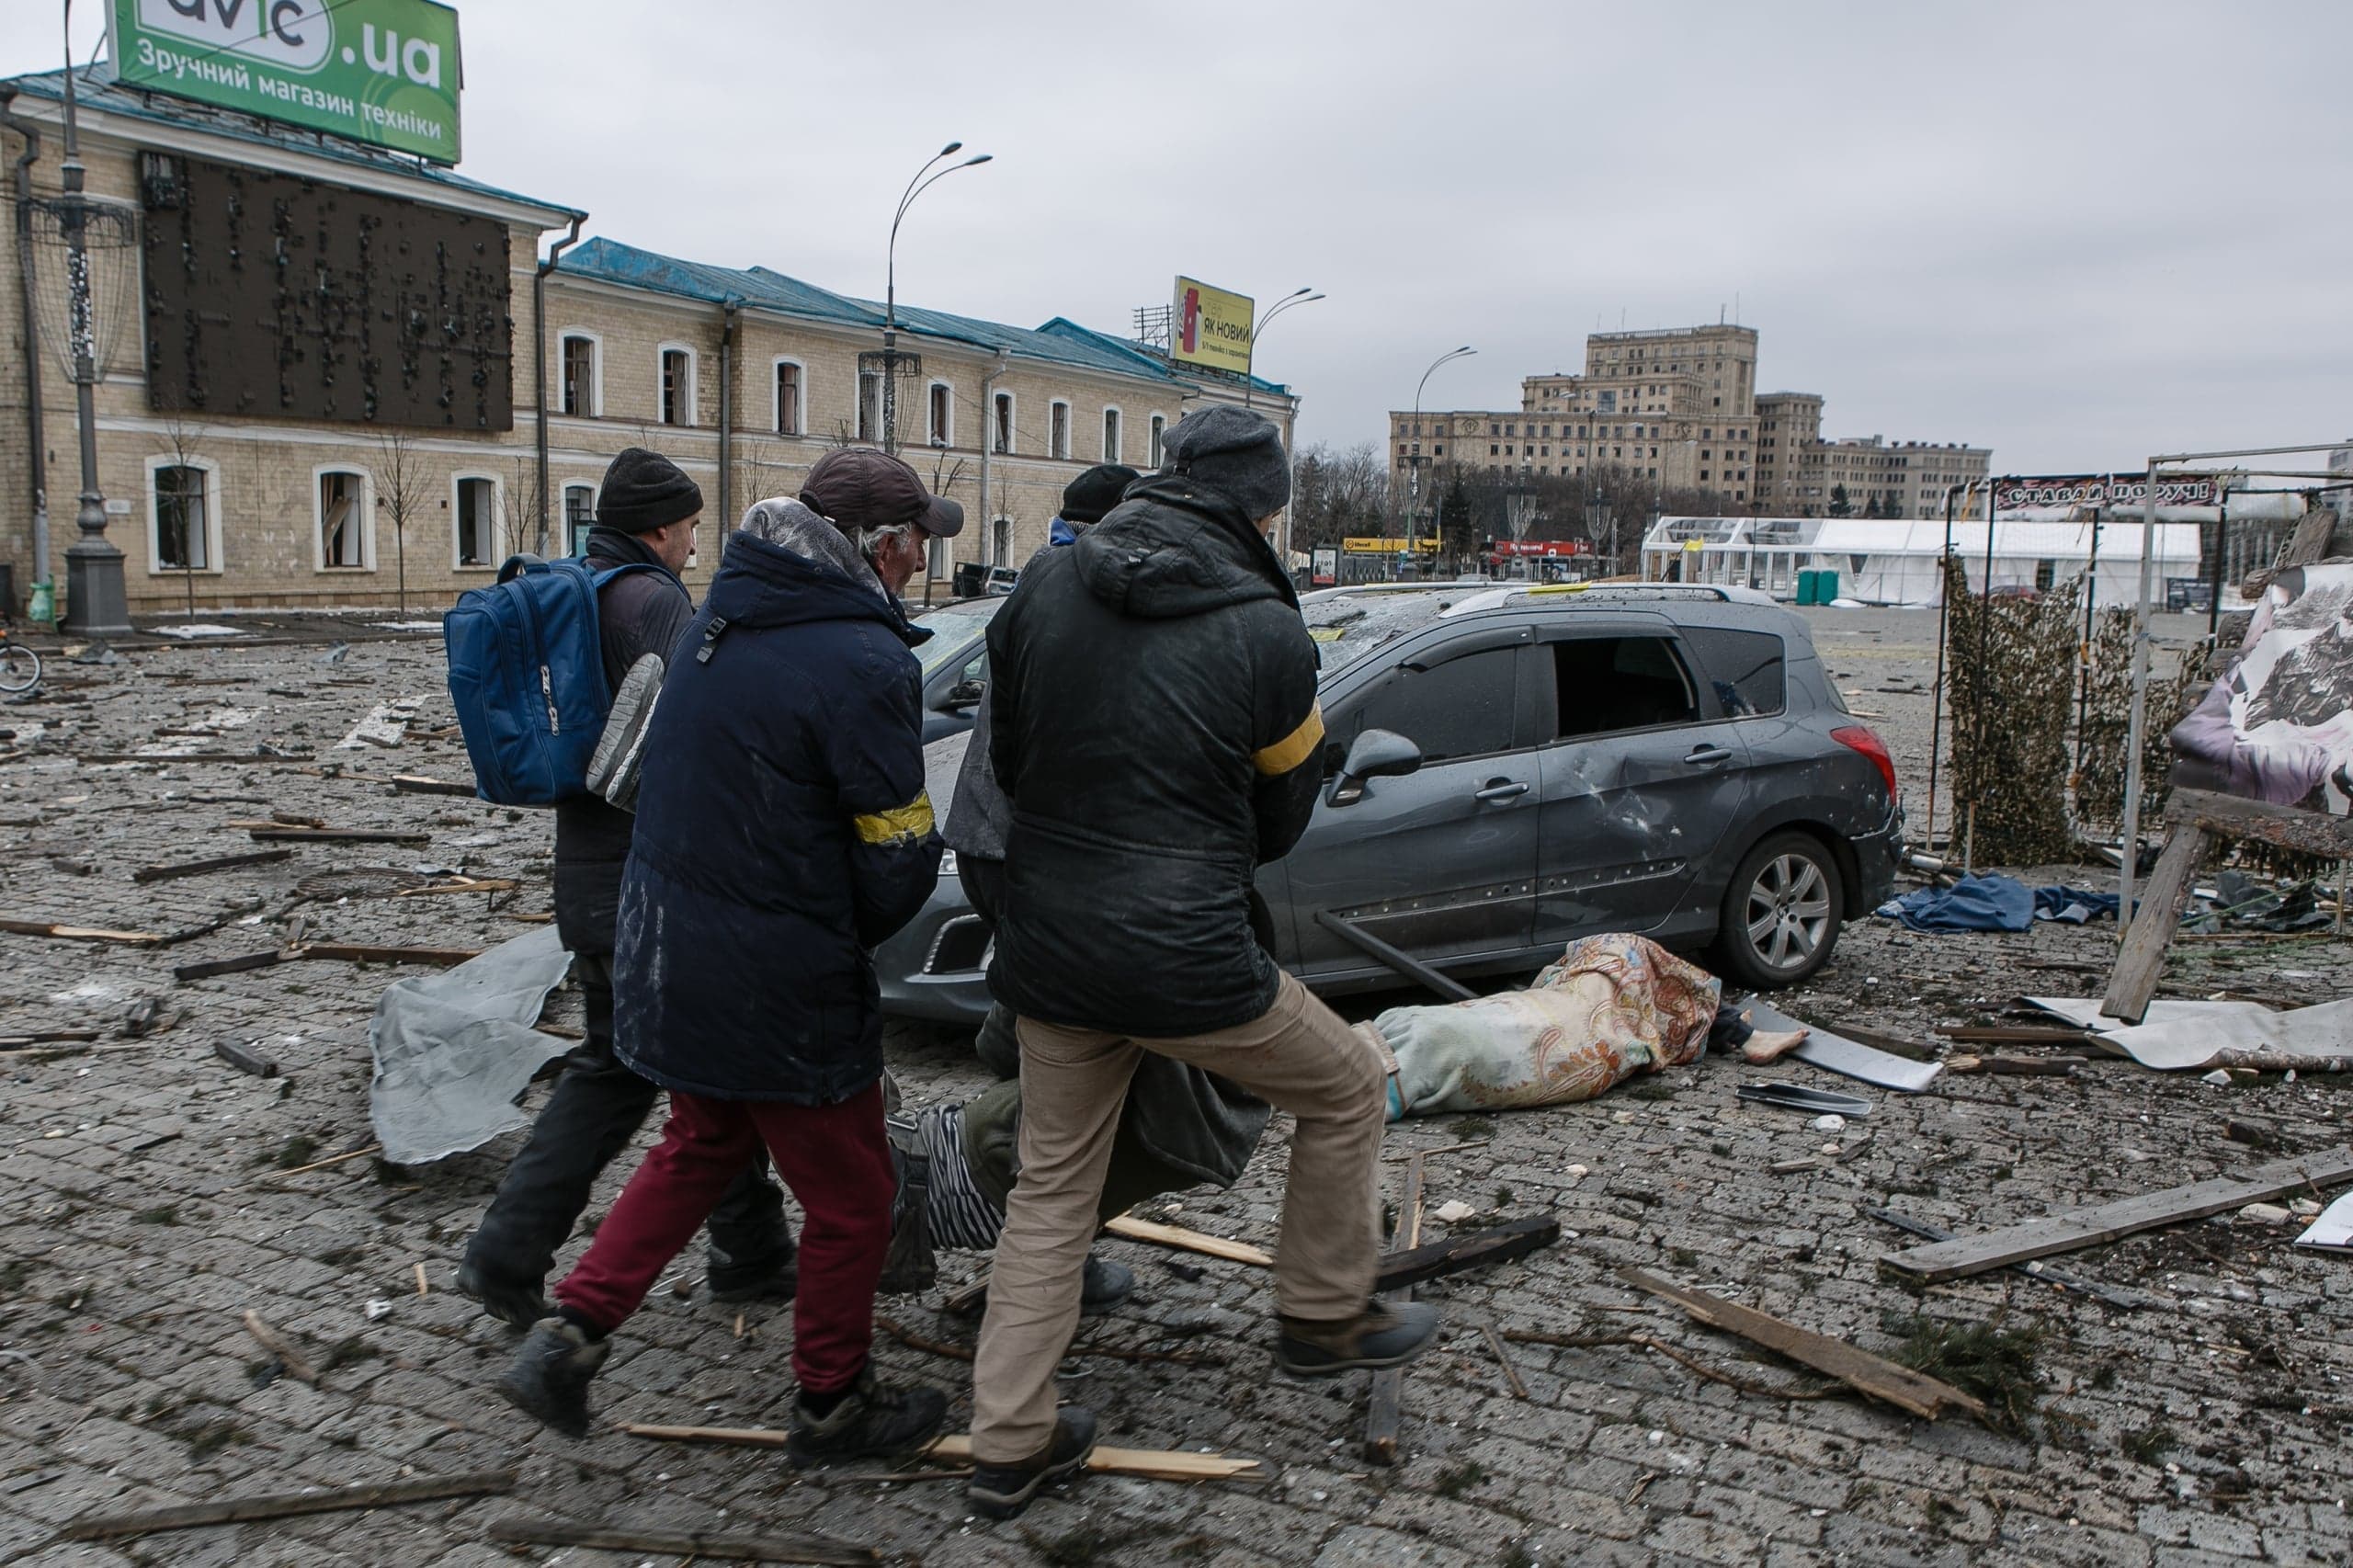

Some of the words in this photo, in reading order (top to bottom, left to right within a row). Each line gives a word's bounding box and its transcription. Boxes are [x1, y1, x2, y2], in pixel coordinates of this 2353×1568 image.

[137, 38, 250, 91] Зручний
[258, 75, 355, 118] магазин
[360, 102, 441, 141] техніки
[1204, 317, 1215, 335] ЯК
[1217, 321, 1249, 344] НОВИЙ
[2009, 483, 2104, 504] СТАВАЙ
